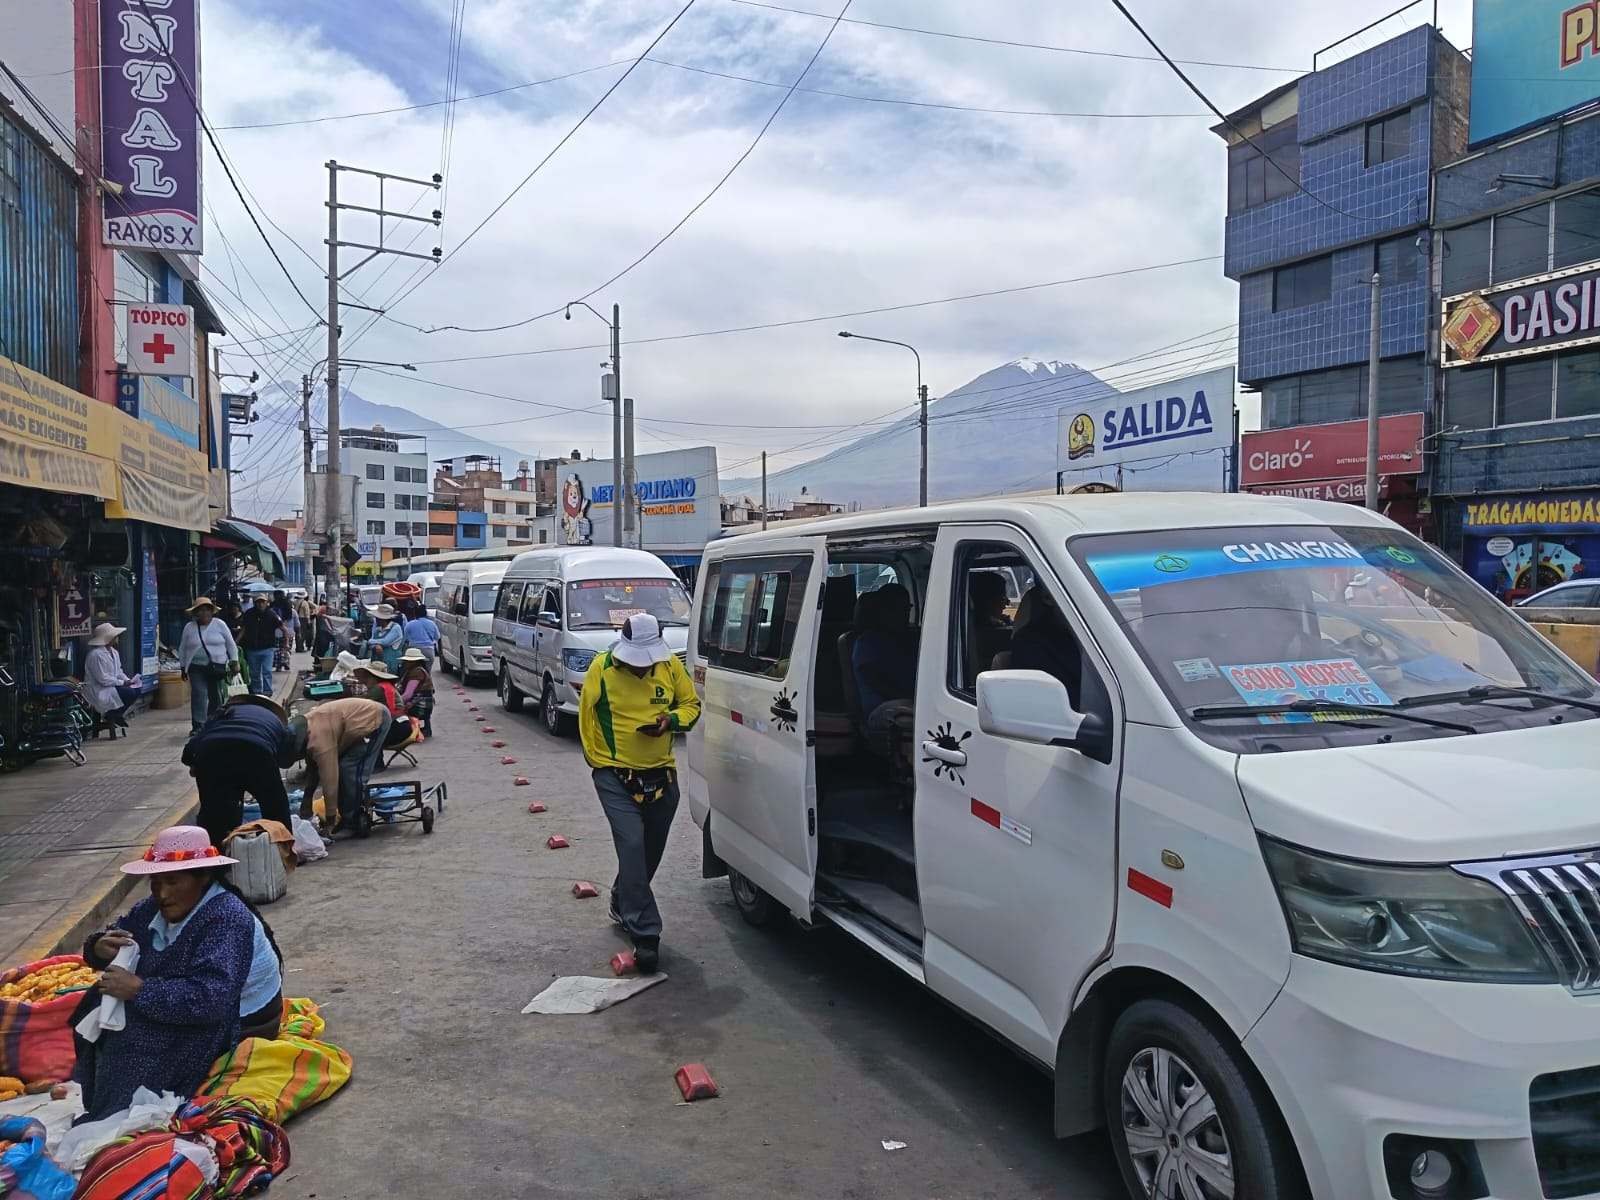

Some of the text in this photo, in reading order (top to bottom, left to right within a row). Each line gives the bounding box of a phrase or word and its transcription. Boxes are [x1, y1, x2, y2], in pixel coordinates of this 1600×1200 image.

[118, 0, 181, 198] NTAL
[108, 221, 194, 246] RAYOS X
[130, 305, 187, 327] TÓPICO
[1103, 390, 1213, 444] SALIDA
[28, 418, 88, 451] EXIGENTES
[1249, 445, 1307, 472] Claro
[1336, 456, 1369, 465] DISTRIBUIDO
[592, 476, 695, 503] METOLITANO
[1325, 485, 1335, 499] A
[1222, 541, 1364, 563] CHANGAN
[1230, 666, 1298, 691] CONO
[1292, 661, 1371, 687] NORTE
